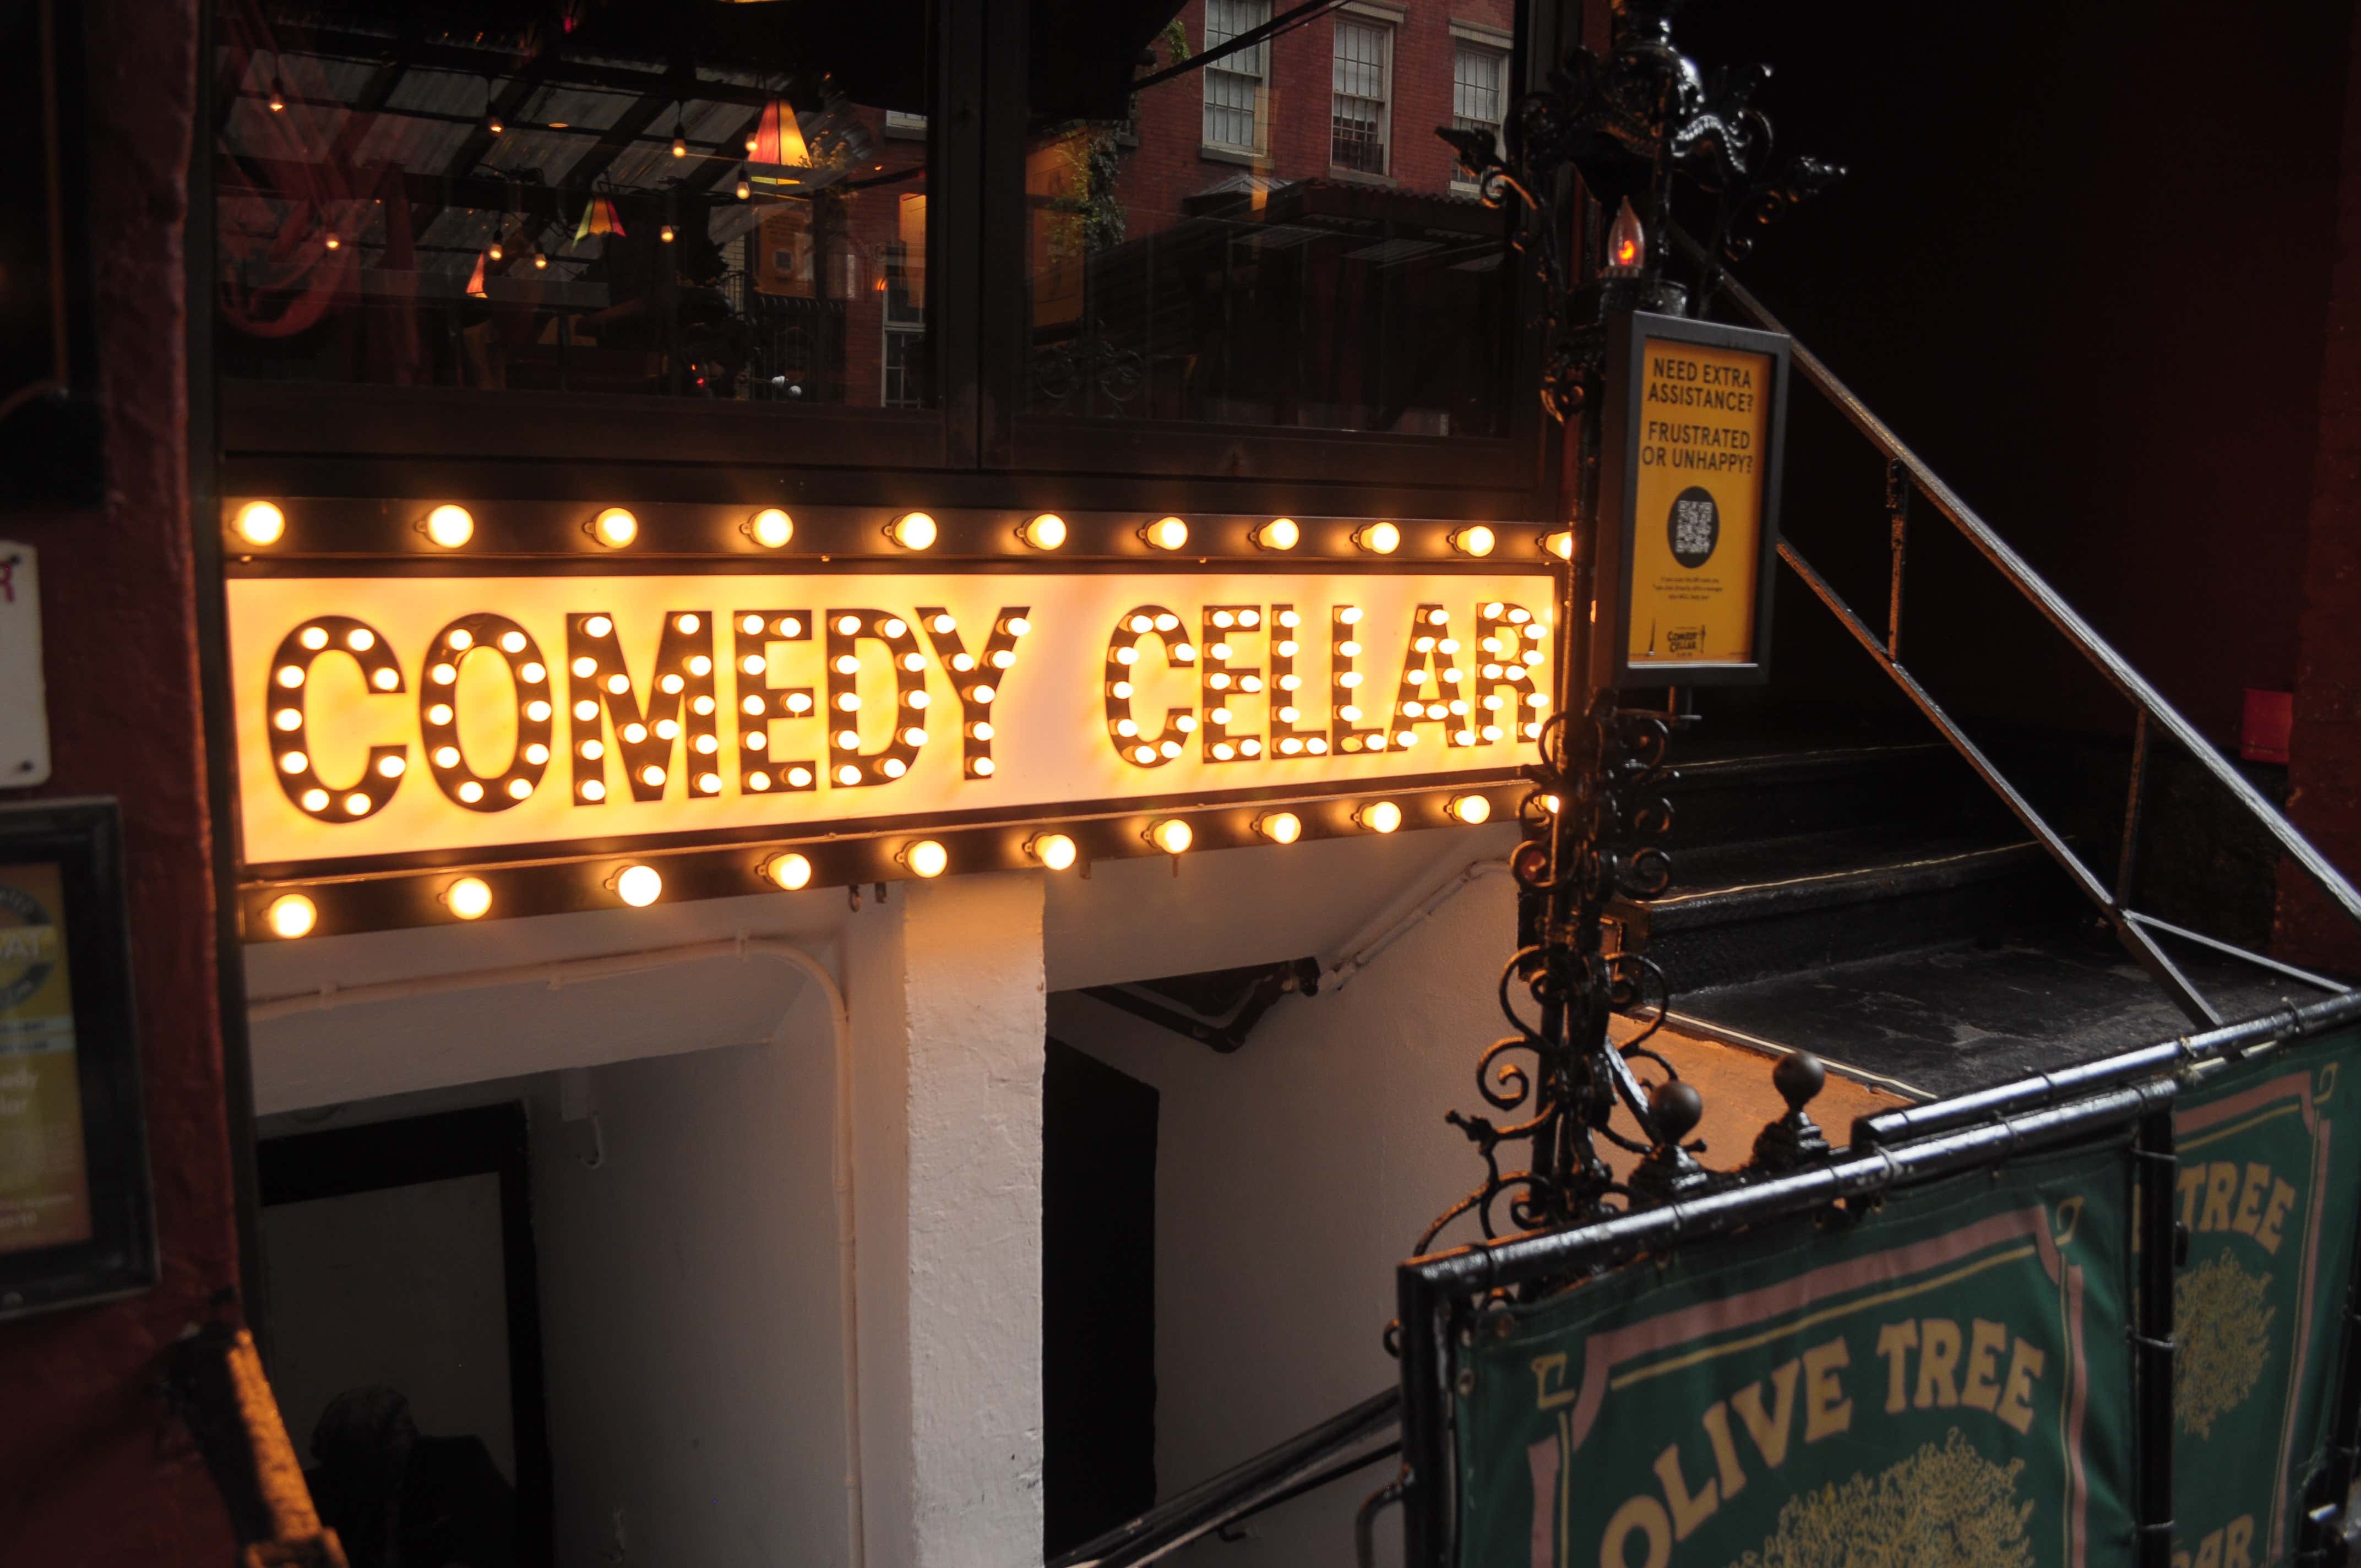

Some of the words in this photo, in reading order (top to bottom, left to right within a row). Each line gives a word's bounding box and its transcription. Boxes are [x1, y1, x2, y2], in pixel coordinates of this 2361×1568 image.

[1653, 357, 1698, 382] NEED
[1703, 364, 1752, 389] EXTRA
[1649, 382, 1754, 413] ASSISTANCE?
[1649, 420, 1750, 450] FRUSTRATED
[1642, 445, 1667, 467] OR
[1672, 448, 1753, 474] UNHAPPY?
[266, 605, 1031, 824] COMEDY
[1104, 602, 1544, 769] CELLAR
[2175, 1161, 2297, 1255] TREE
[1599, 1335, 1853, 1568] OLIVE
[1875, 1317, 2045, 1435] TREE
